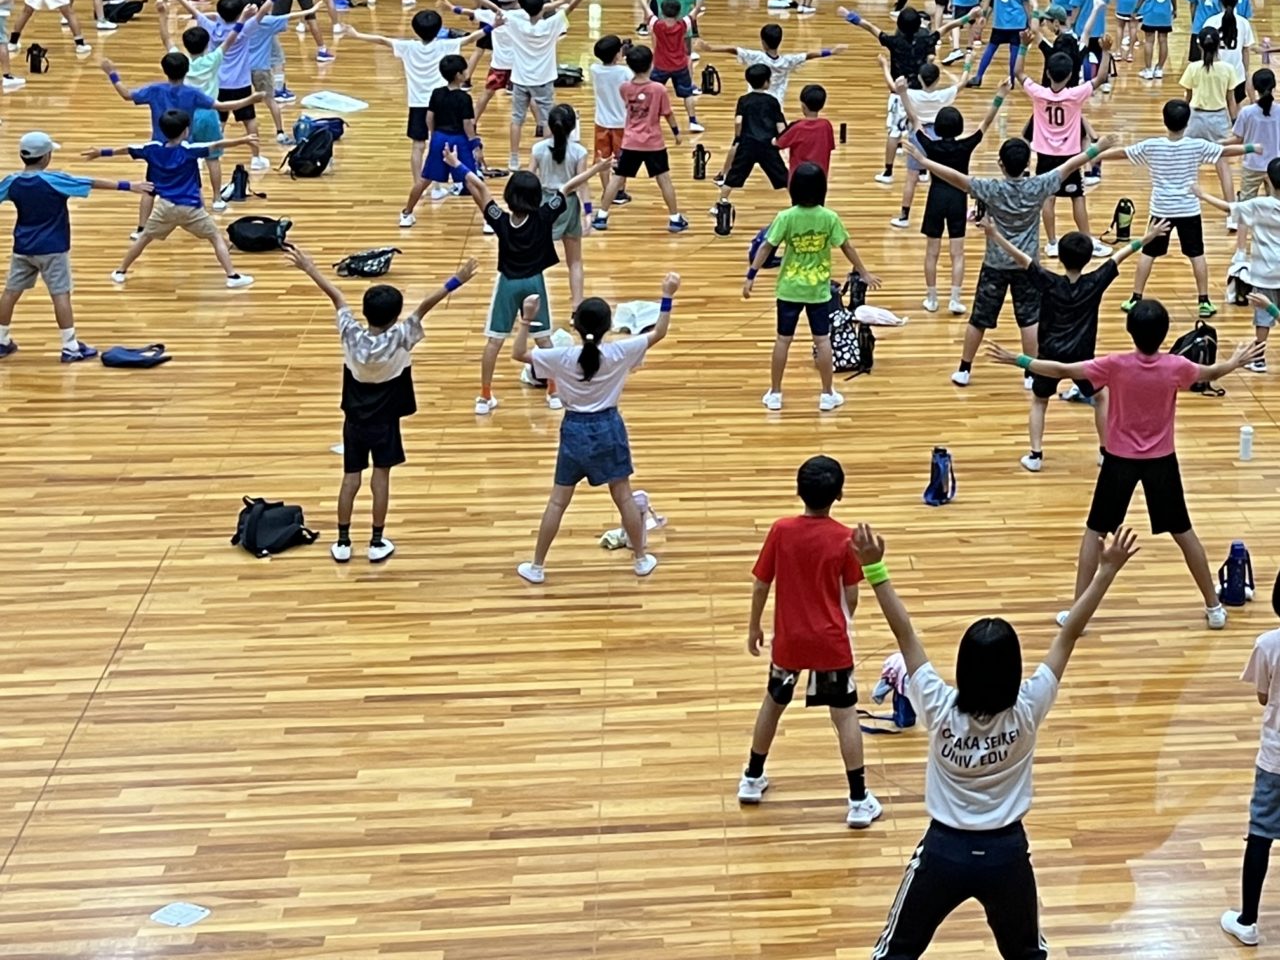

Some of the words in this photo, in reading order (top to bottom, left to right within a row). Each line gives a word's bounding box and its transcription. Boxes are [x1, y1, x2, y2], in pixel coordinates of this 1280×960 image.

[1045, 106, 1065, 127] 10
[942, 728, 980, 750] OAKA
[980, 750, 1008, 766] EDU
